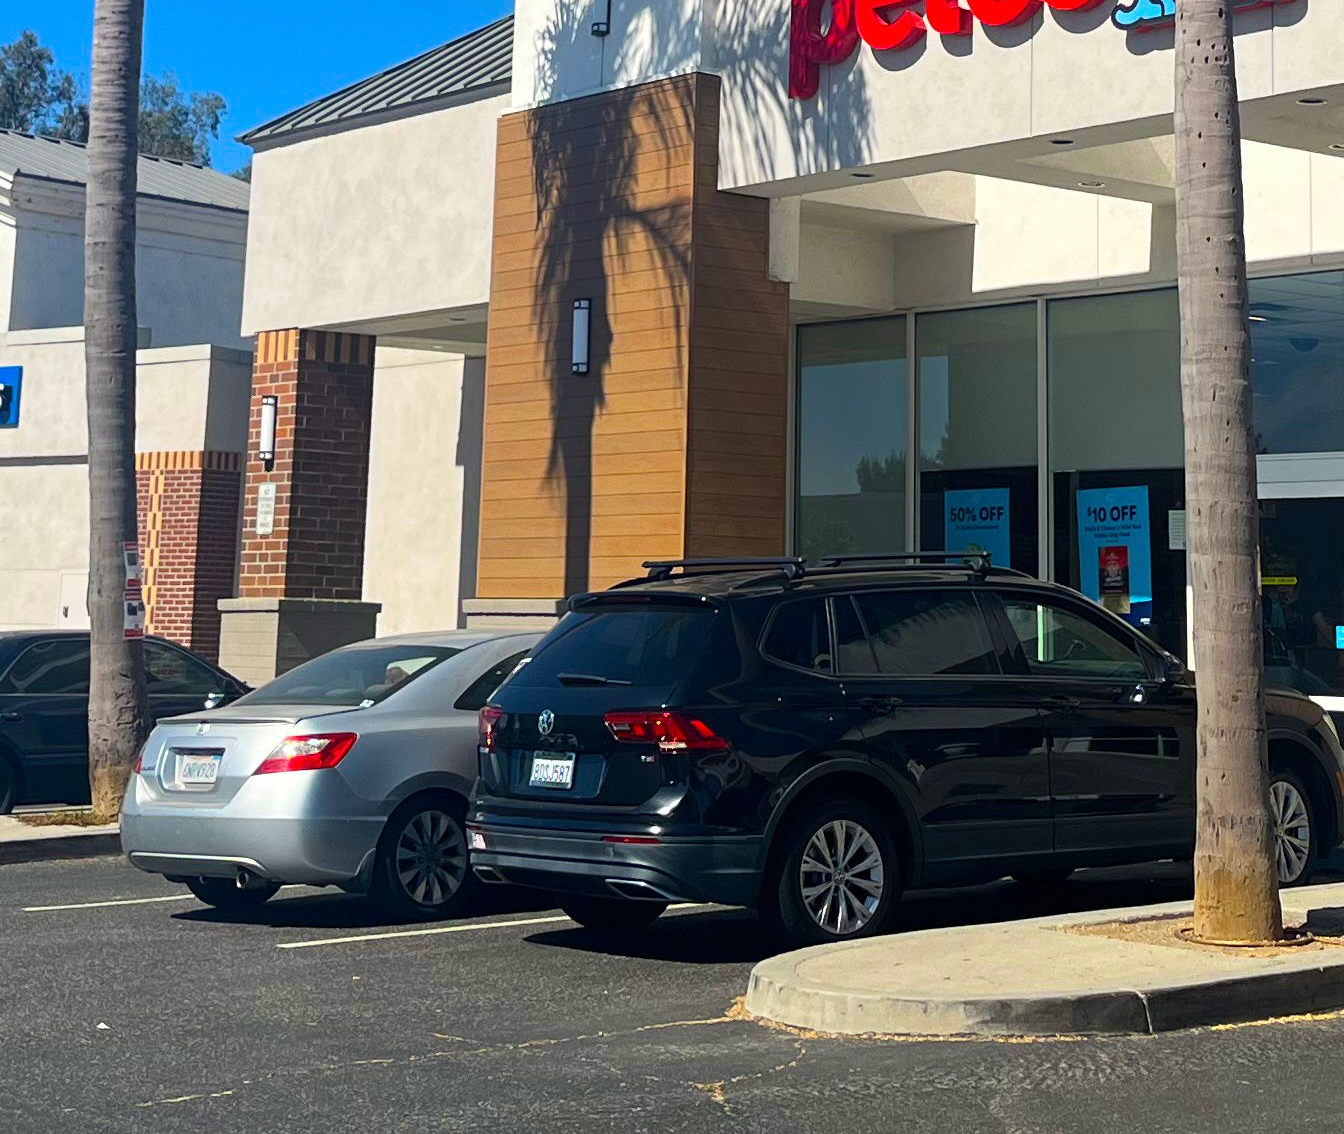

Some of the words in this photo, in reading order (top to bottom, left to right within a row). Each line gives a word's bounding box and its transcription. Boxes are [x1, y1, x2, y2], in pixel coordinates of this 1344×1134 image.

[950, 507, 977, 522] 50%
[979, 506, 1004, 521] OFF
[1087, 506, 1107, 522] $10
[1110, 505, 1137, 522] OFF
